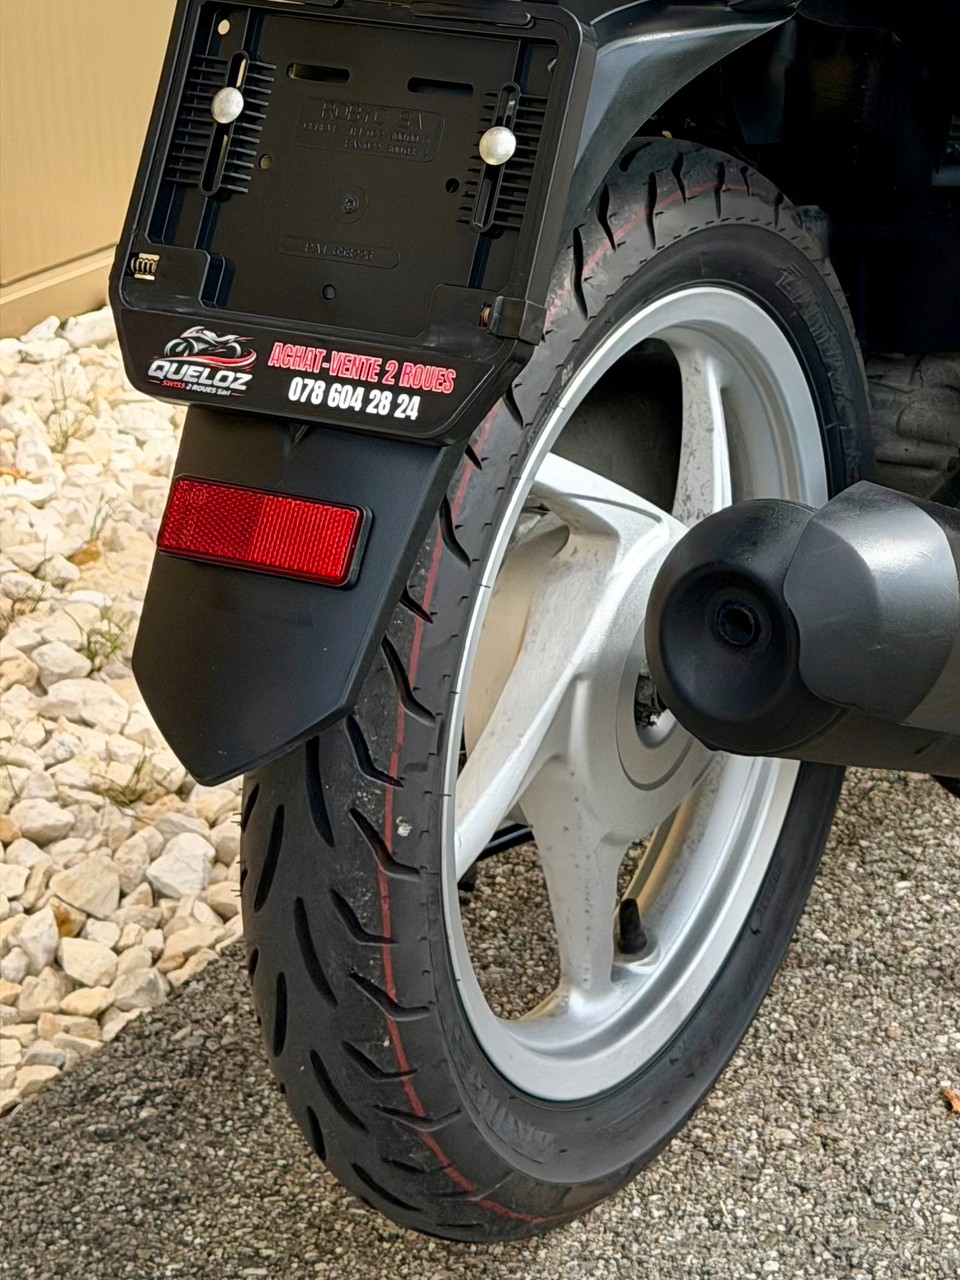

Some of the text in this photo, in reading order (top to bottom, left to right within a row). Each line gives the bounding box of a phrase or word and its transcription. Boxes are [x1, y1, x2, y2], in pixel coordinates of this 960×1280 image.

[147, 360, 253, 390] QUELOZ
[268, 342, 456, 394] ACHAT-VENTE 2 ROUES
[192, 384, 216, 394] ROUES
[288, 377, 421, 421] 078 604 28 24
